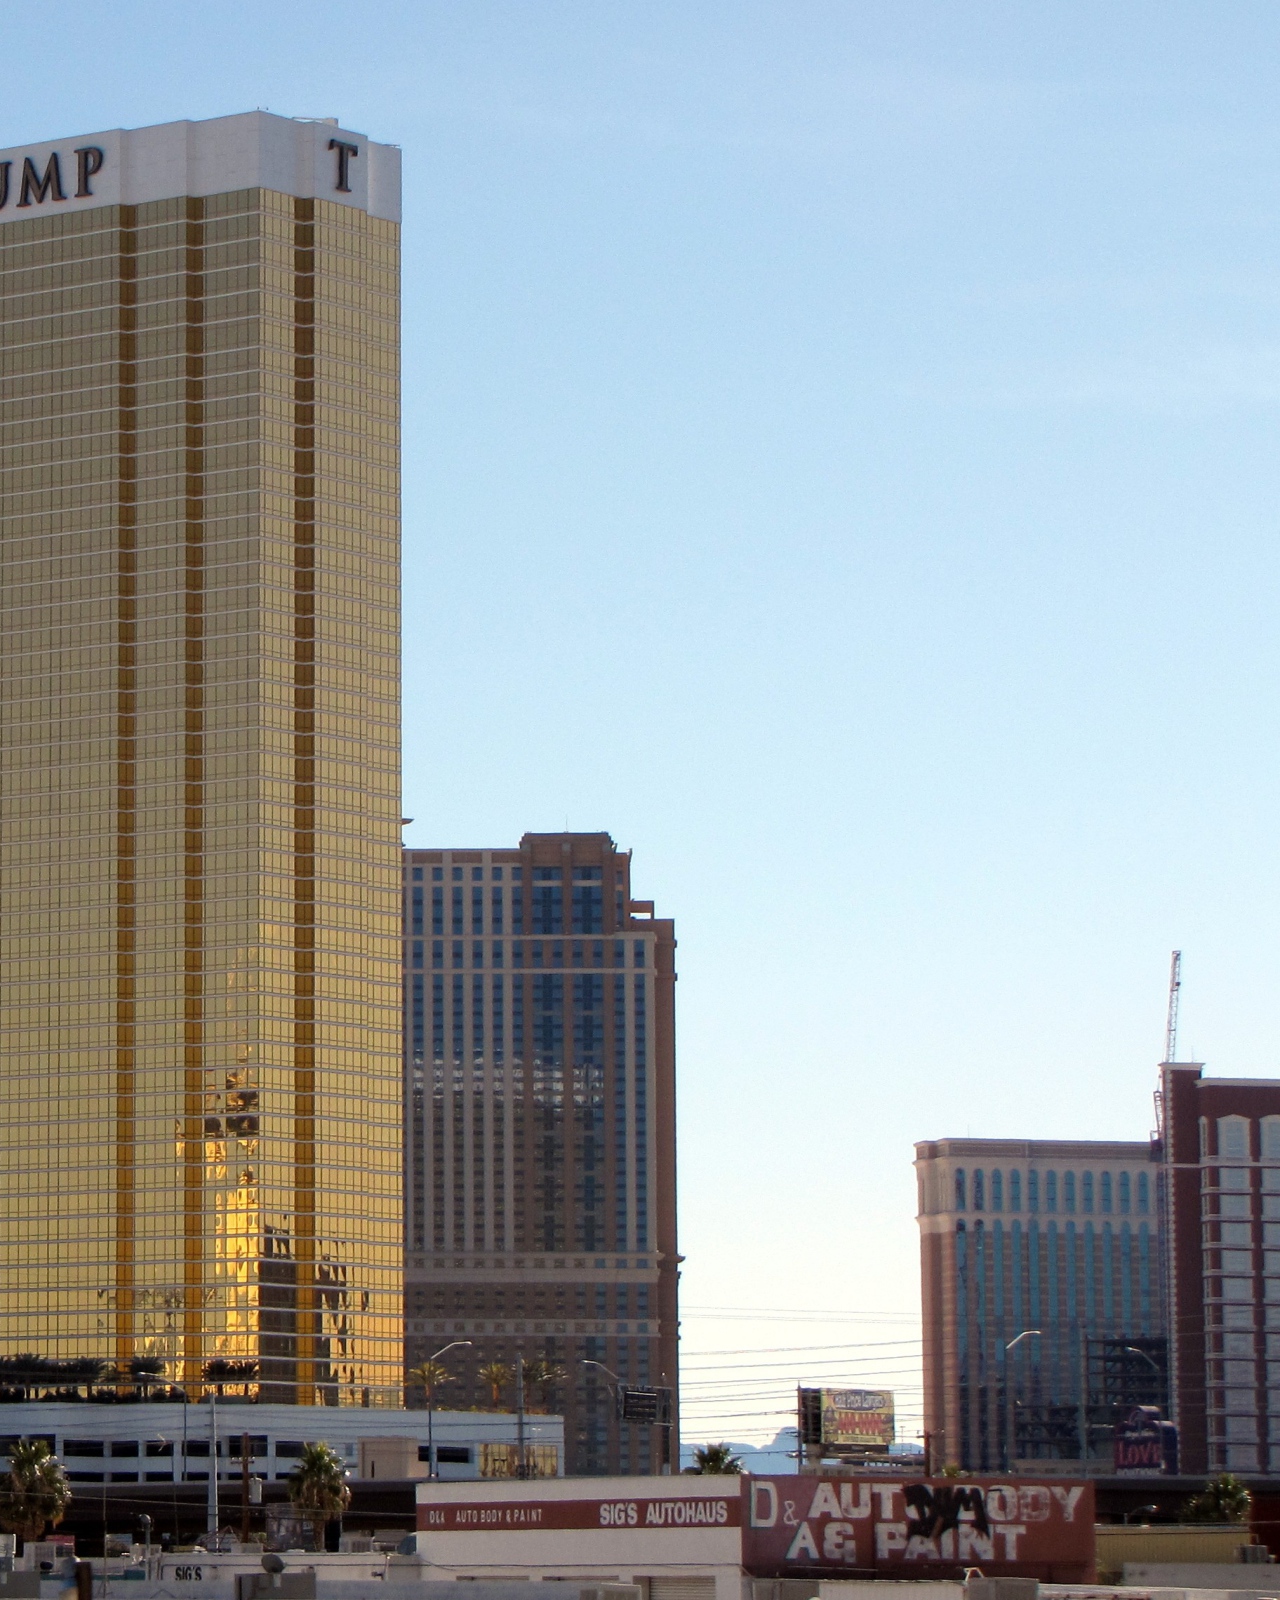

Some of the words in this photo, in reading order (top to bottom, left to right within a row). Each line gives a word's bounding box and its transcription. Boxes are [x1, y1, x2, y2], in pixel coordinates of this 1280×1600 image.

[327, 138, 359, 193] T
[455, 1510, 478, 1523] AUTO
[480, 1510, 503, 1523] BODY
[505, 1510, 512, 1523] &
[513, 1508, 543, 1523] PAINT
[599, 1502, 639, 1525] SIG'S
[645, 1501, 728, 1524] AUTOHAUS
[750, 1481, 778, 1527] D
[783, 1500, 800, 1526] &
[785, 1521, 821, 1560] A
[823, 1521, 857, 1563] &
[875, 1522, 1027, 1561] PAINT
[175, 1566, 203, 1580] SIG'S
